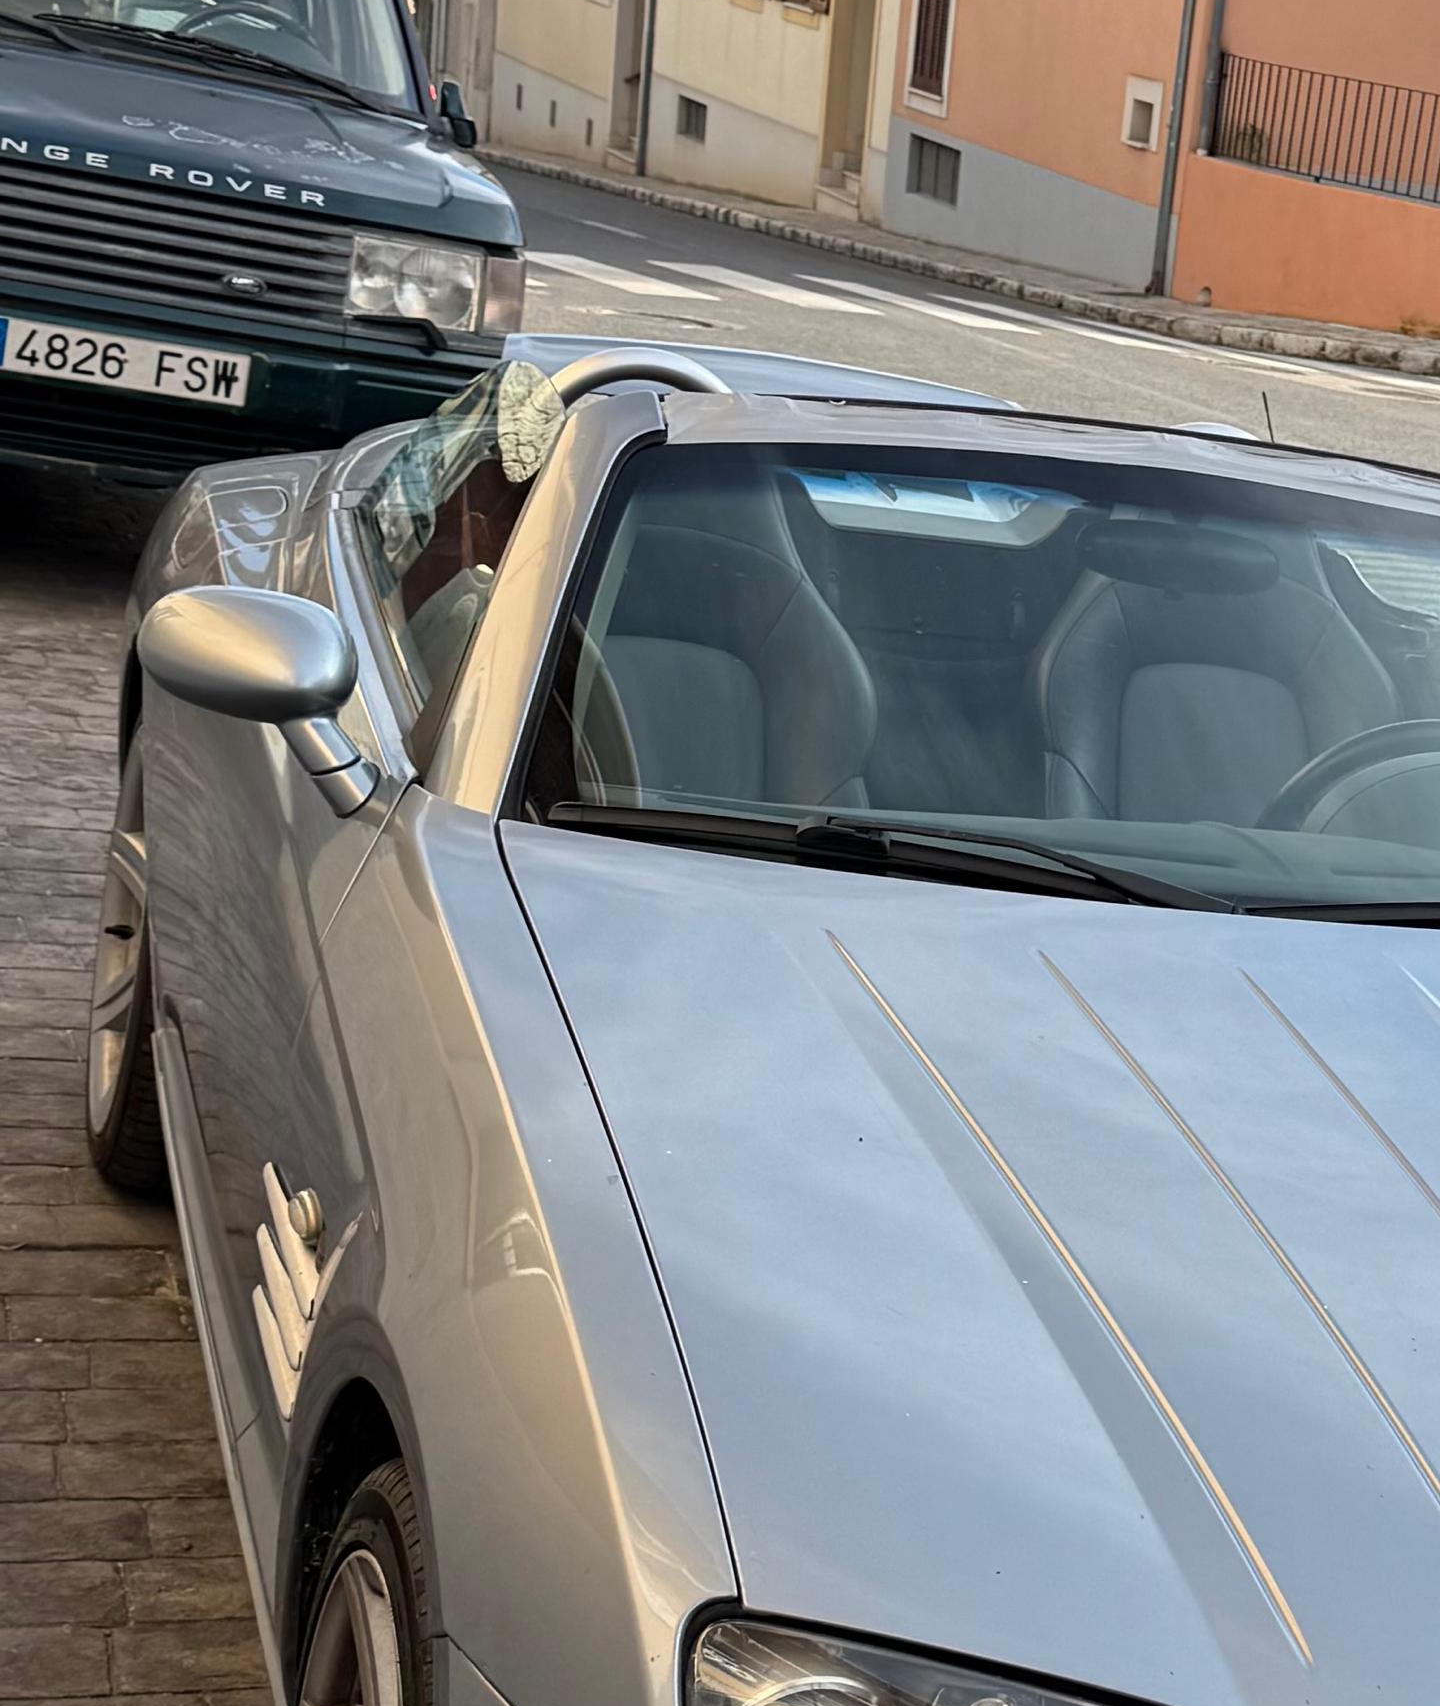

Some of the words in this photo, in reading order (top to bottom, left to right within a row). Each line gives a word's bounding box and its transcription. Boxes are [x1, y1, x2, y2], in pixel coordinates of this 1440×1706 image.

[150, 163, 325, 206] ROVER
[15, 329, 127, 379] 4826
[154, 350, 238, 398] FSW
